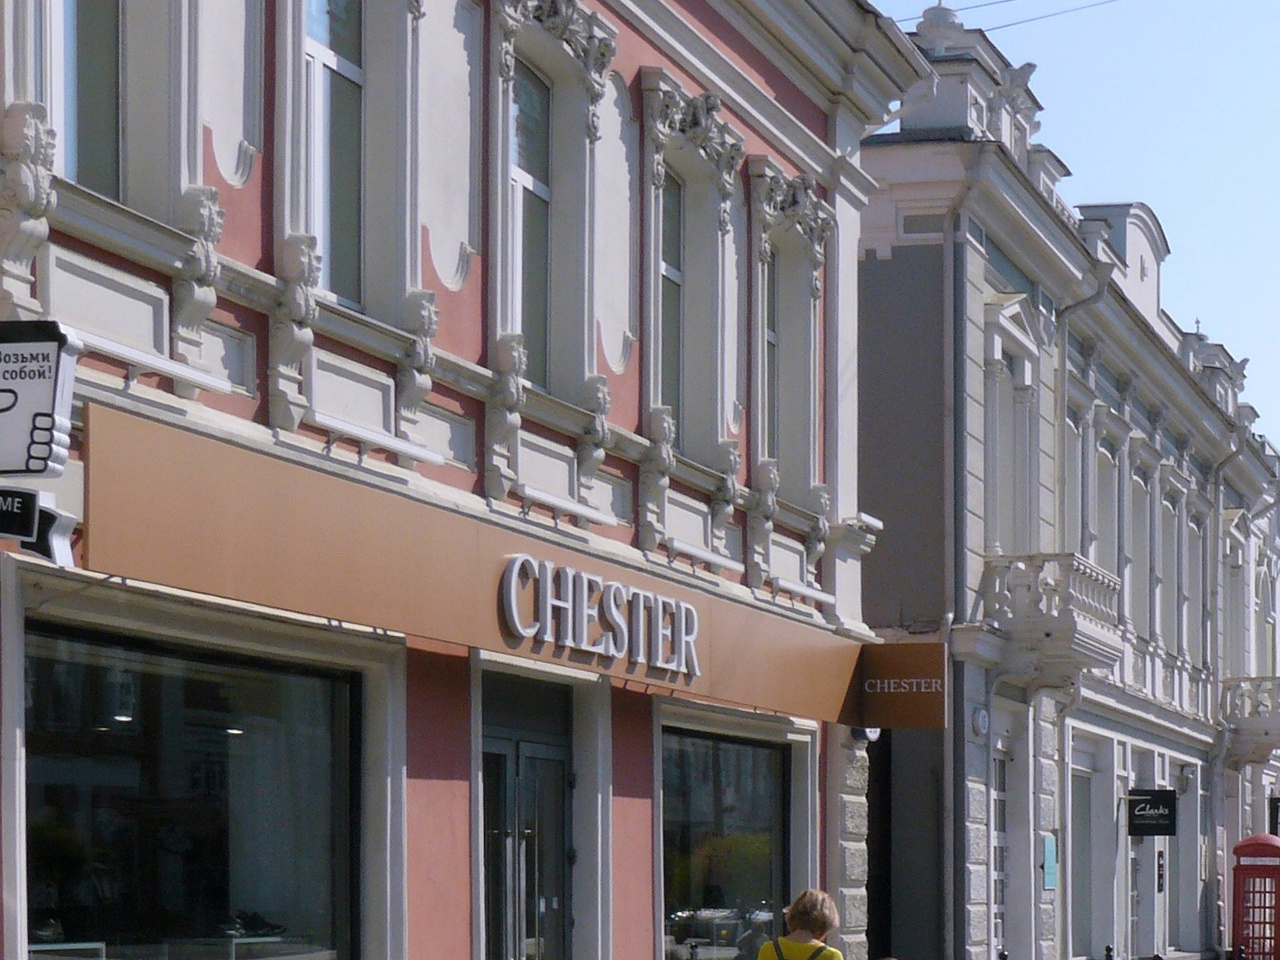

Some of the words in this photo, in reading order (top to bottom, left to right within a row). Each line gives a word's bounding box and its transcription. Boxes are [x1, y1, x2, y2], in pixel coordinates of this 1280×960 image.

[0, 351, 50, 364] озьми
[2, 365, 52, 380] собой!
[501, 552, 702, 677] CHESTER
[864, 679, 943, 693] CHESTER
[1134, 803, 1169, 815] Clarks
